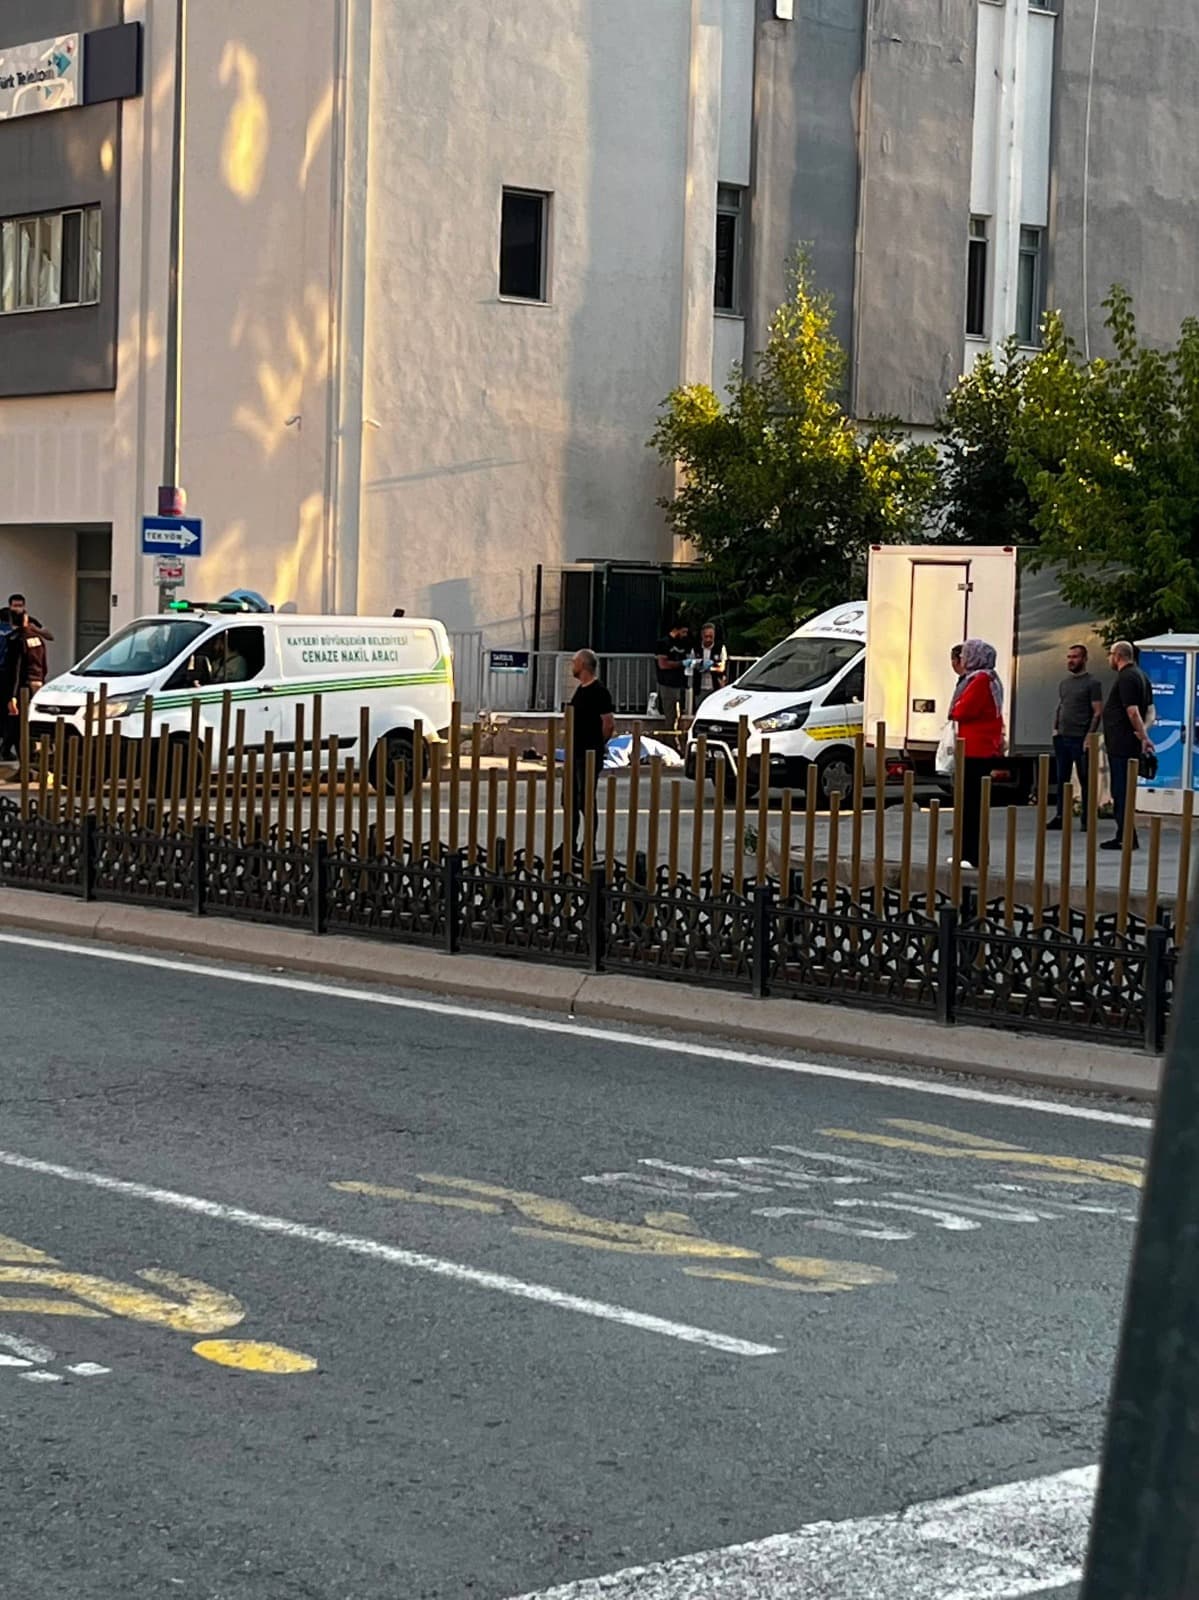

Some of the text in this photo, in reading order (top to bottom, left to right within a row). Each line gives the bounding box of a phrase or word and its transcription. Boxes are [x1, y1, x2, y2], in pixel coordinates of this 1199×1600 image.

[16, 68, 55, 85] Telekom
[146, 531, 183, 541] TEK YÖN
[287, 635, 408, 647] KAYSERİ BÜYÜKŞEHİR BELEDİYESİ
[302, 648, 399, 663] CENAZE NAKİL ARACI
